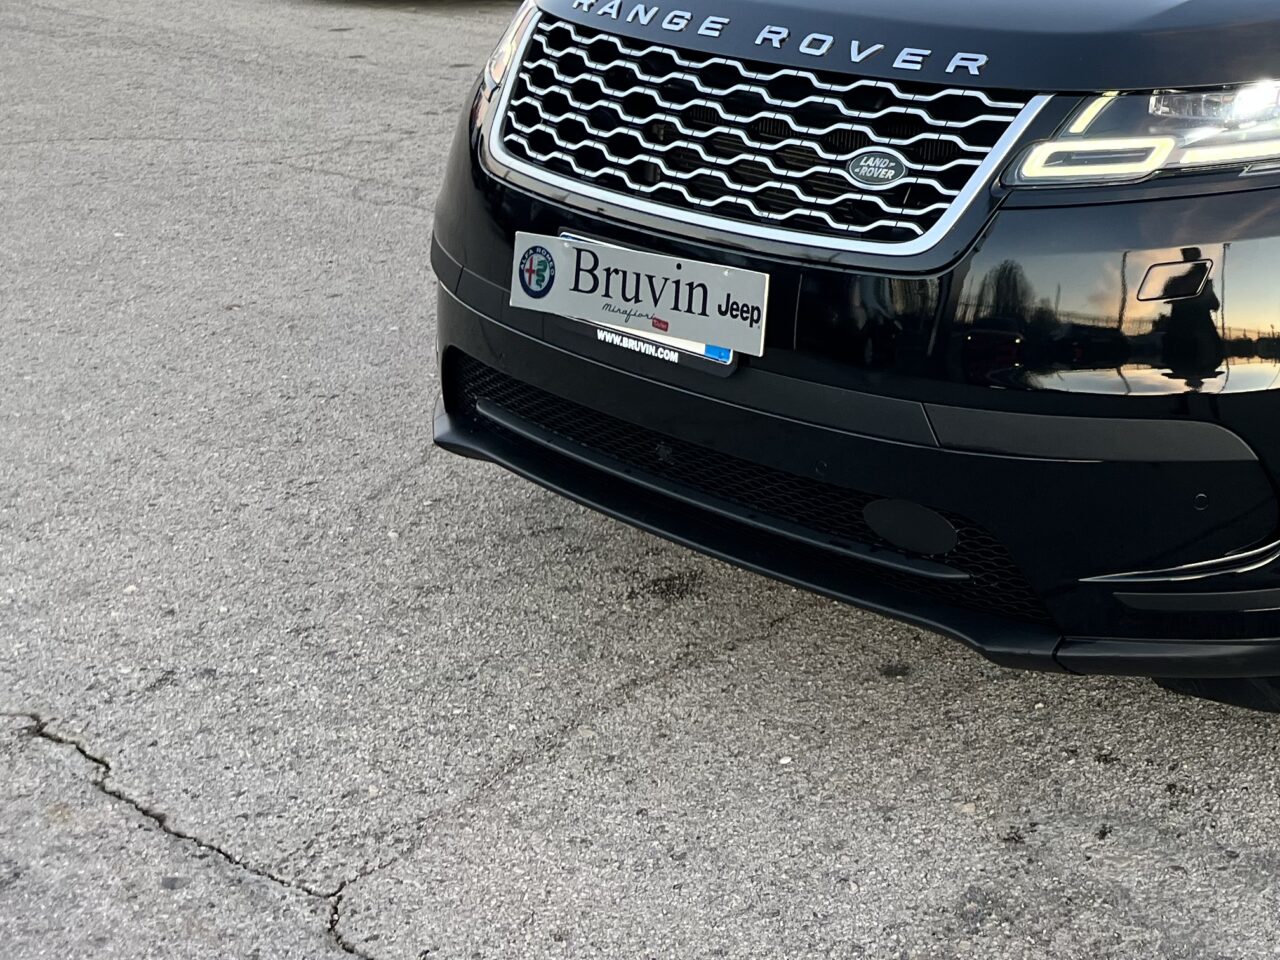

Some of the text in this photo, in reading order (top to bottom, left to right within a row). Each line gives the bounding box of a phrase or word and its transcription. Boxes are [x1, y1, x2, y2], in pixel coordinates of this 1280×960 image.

[754, 24, 989, 76] ROVER
[859, 156, 890, 168] LAND
[859, 166, 895, 180] ROVER
[569, 247, 710, 318] Bruvin
[602, 302, 655, 323] Mirafiori
[717, 292, 762, 328] Jeep
[596, 328, 679, 364] WWW.BRUVIN.COM
